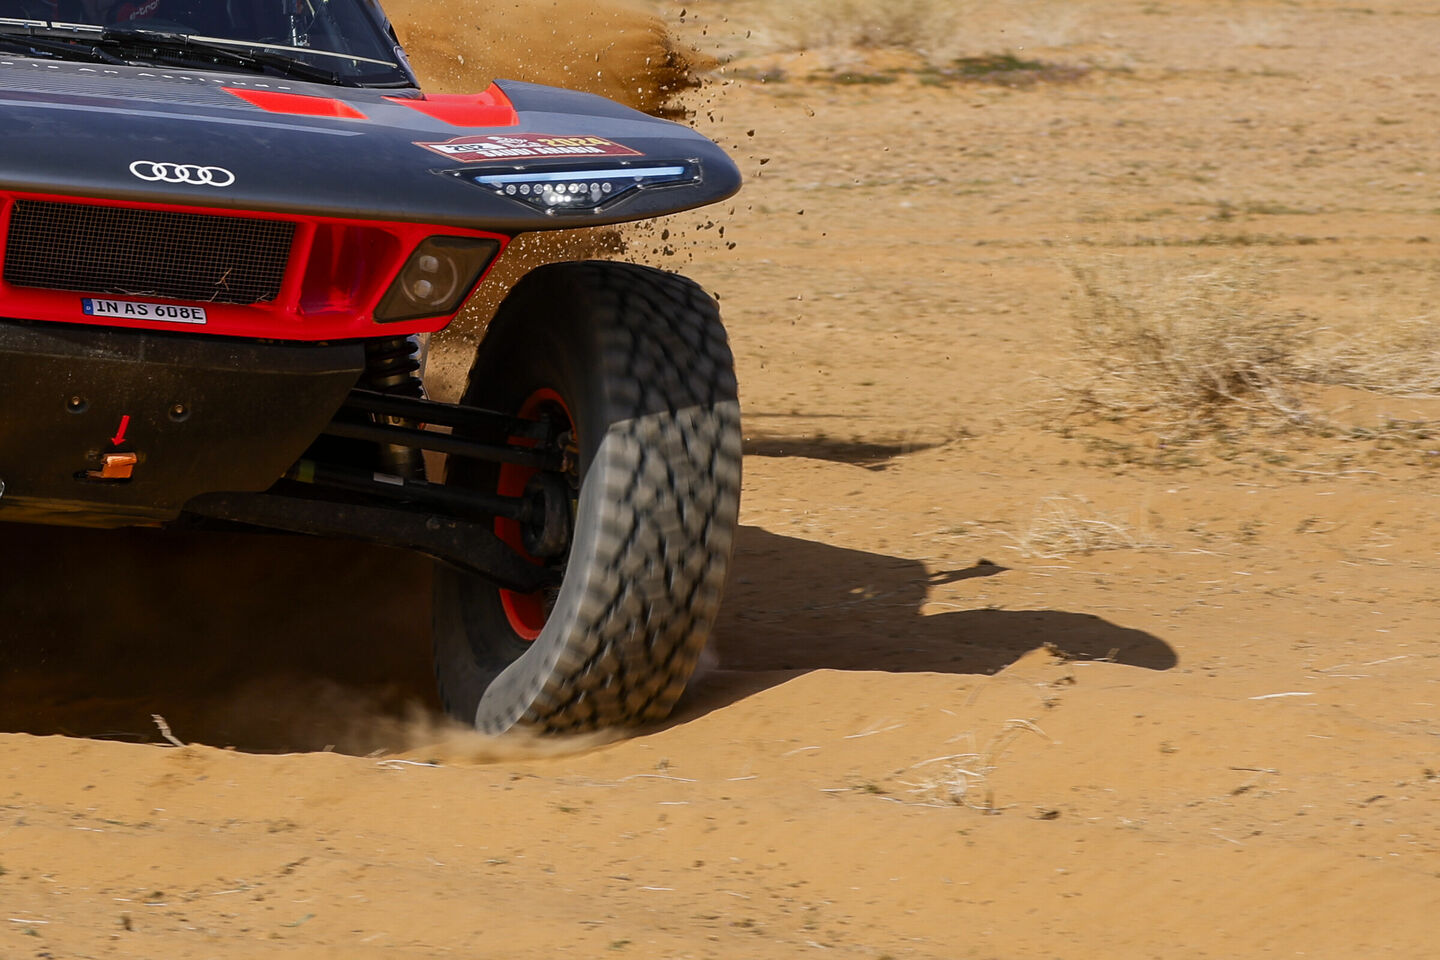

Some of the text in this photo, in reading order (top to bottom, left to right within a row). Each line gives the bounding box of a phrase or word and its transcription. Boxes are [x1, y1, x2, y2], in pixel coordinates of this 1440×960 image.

[537, 138, 611, 147] 2024
[97, 301, 204, 320] IN AS 608E
